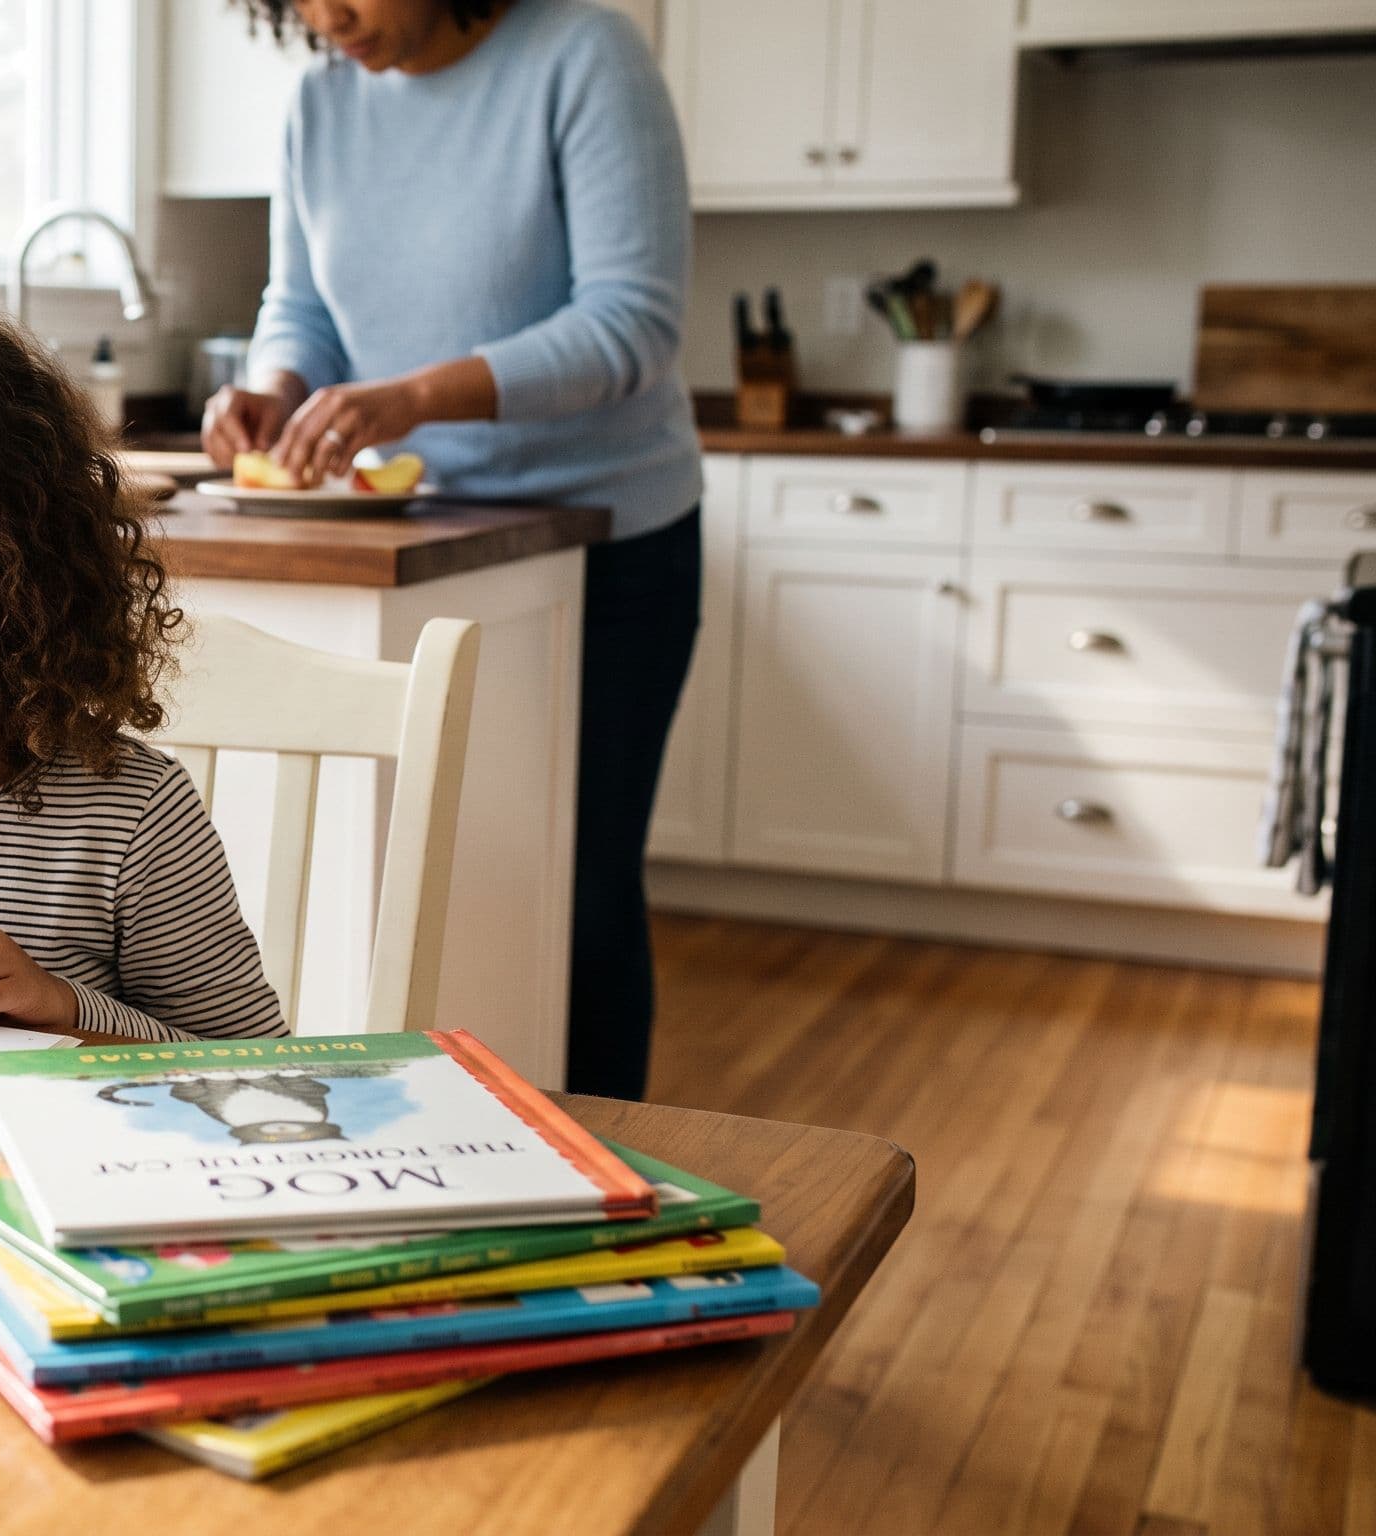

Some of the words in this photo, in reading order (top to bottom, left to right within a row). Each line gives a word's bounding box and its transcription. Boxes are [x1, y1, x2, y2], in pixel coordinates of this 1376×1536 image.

[188, 1144, 427, 1169] FORGETFUL
[438, 1141, 525, 1157] THE
[96, 1159, 172, 1174] CAT
[207, 1164, 456, 1201] MOG
